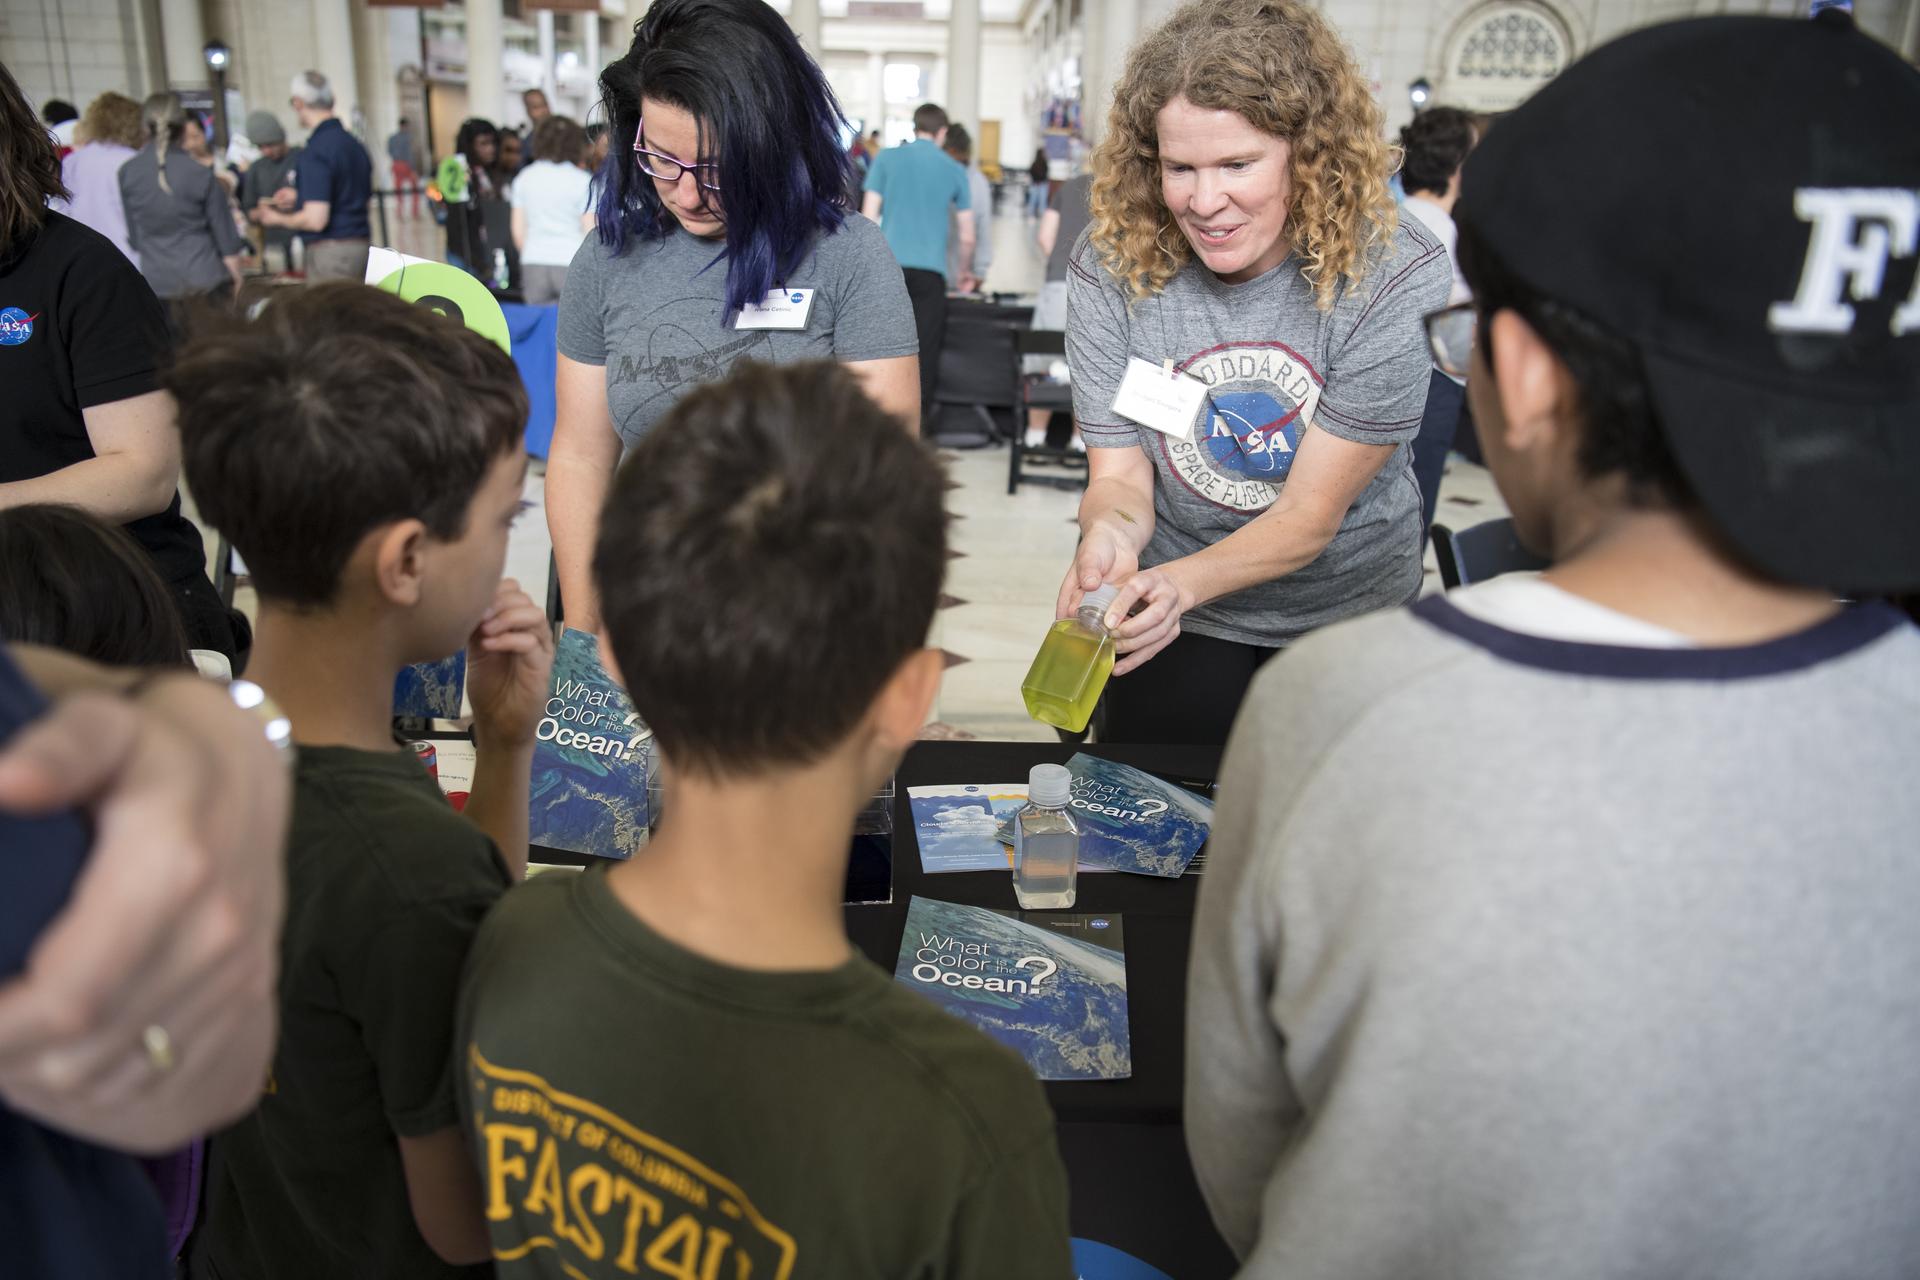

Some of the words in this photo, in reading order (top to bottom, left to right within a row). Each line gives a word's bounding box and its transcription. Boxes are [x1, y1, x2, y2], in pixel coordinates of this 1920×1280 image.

[1765, 185, 1920, 335] F
[0, 321, 30, 333] ASA
[1199, 354, 1310, 399] ODDARD
[1211, 414, 1293, 455] NSA
[1172, 441, 1221, 496] SPACE
[556, 676, 612, 708] What
[545, 697, 606, 726] Color
[608, 712, 619, 722] is
[605, 720, 624, 733] the
[1070, 773, 1123, 794] What
[1068, 793, 1169, 822] cean?
[920, 932, 991, 957] What
[916, 948, 991, 971] Color
[996, 959, 1008, 967] is
[996, 964, 1018, 975] the
[912, 955, 1058, 995] Ocean?
[575, 1120, 609, 1151] OF
[606, 1135, 709, 1209] COLUMBIA
